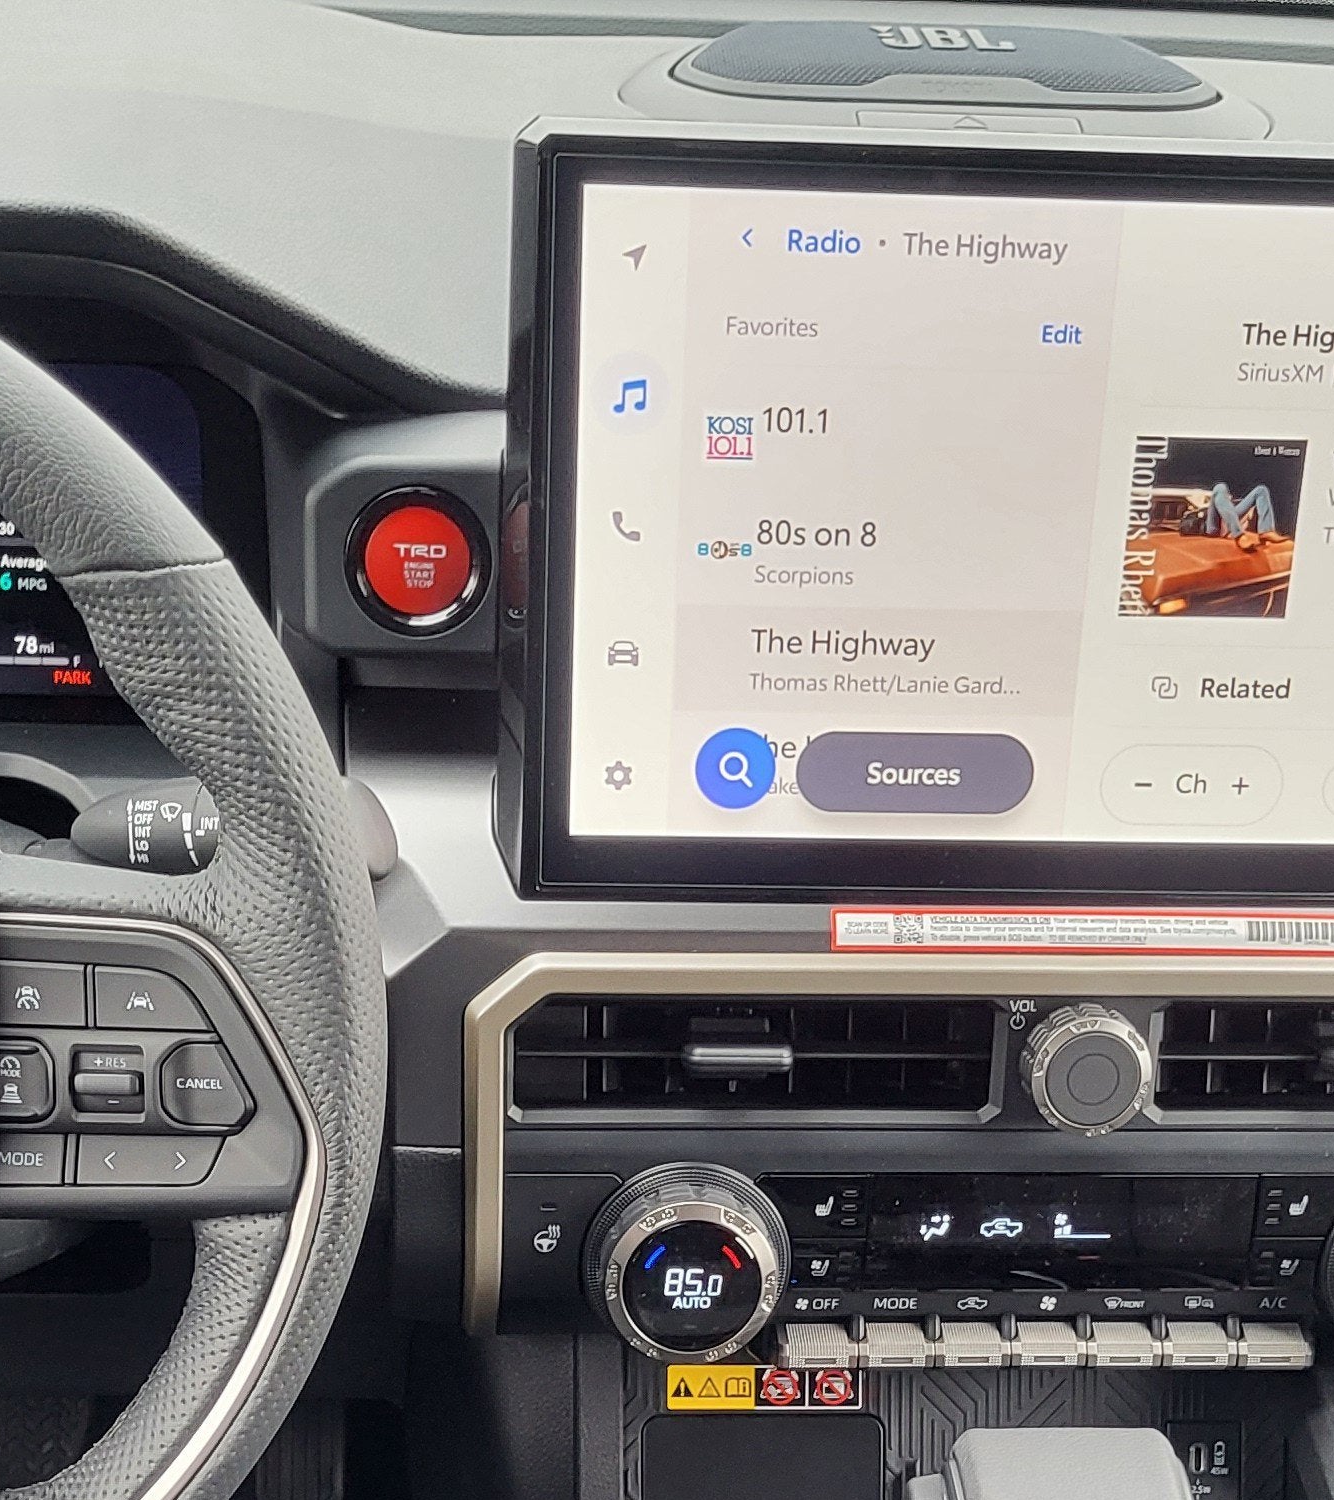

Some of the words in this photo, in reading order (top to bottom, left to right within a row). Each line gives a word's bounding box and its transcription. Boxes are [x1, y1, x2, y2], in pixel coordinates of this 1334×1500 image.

[881, 25, 1017, 52] JBL
[787, 228, 861, 255] Radio
[904, 232, 948, 258] The
[955, 234, 1068, 265] Highway
[726, 316, 818, 339] Favorites
[1041, 324, 1083, 345] Edit
[1243, 323, 1286, 347] The
[1238, 362, 1323, 384] SiriusXM
[706, 416, 754, 435] KOSI
[762, 407, 829, 435] 101.1
[706, 436, 754, 456] 101.1
[757, 520, 806, 547] 80s
[814, 524, 851, 547] on
[860, 522, 877, 547] 8
[393, 543, 447, 559] TRD
[17, 577, 48, 591] MPG
[403, 570, 435, 579] START
[406, 579, 434, 588] STOP
[754, 565, 854, 588] Scorpions
[751, 629, 803, 654] The
[811, 630, 935, 663] Highway
[53, 670, 92, 685] PARK
[750, 673, 827, 693] Thomas
[834, 674, 948, 696] Rhett/Lanie
[1200, 678, 1291, 701] Related
[867, 762, 961, 787] Sources
[1176, 774, 1208, 796] Ch
[135, 800, 159, 811] MIST
[134, 813, 153, 825] OFF
[135, 826, 152, 838] INT
[135, 839, 149, 851] LO
[1009, 1000, 1037, 1013] VOL
[176, 1077, 223, 1091] CANCEL
[664, 1268, 723, 1297] 85.0
[672, 1297, 712, 1309] AUTO
[812, 1298, 840, 1310] OFF
[873, 1297, 918, 1310] MODE
[1259, 1297, 1287, 1309] A/C
